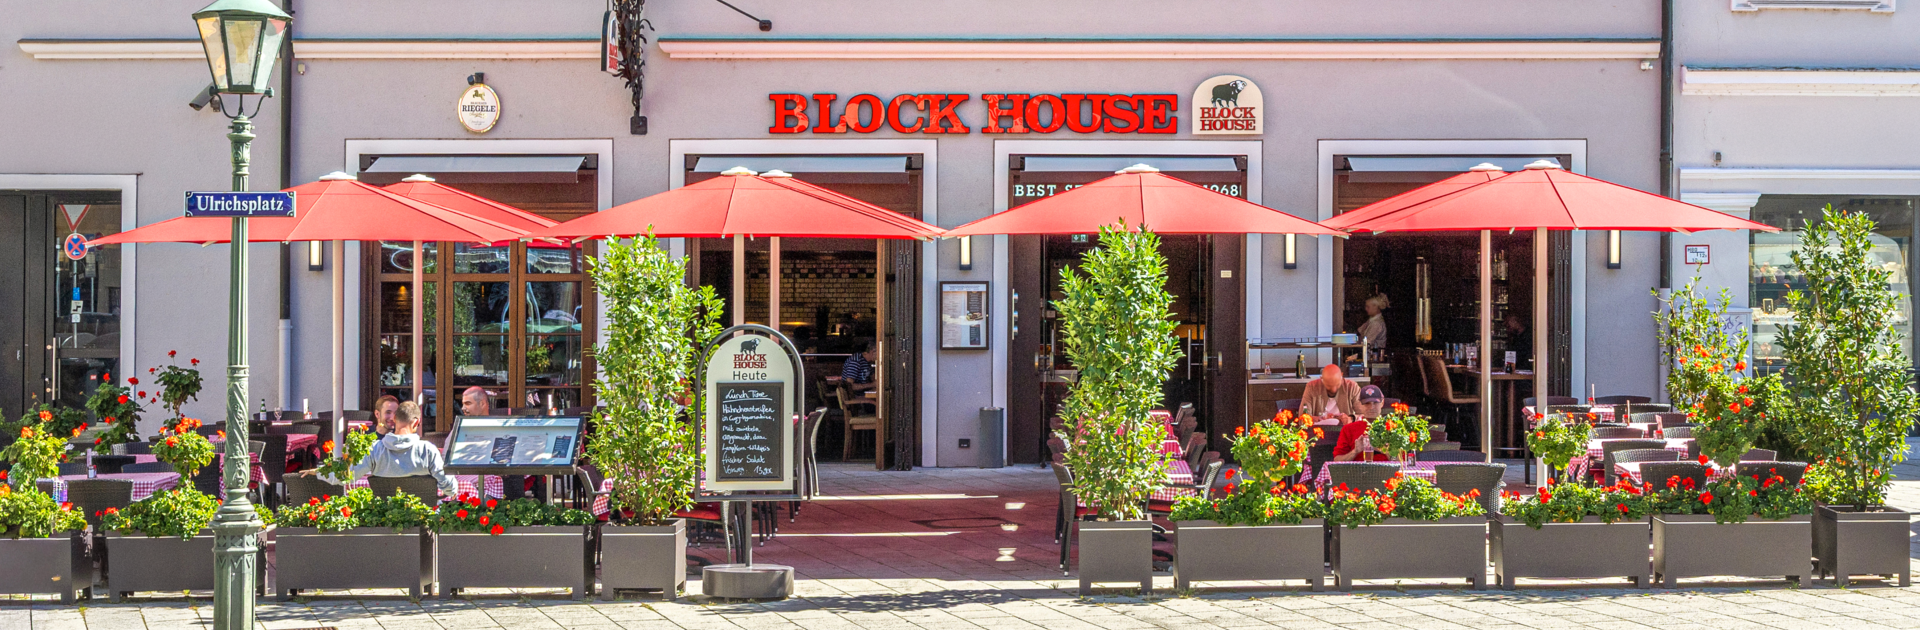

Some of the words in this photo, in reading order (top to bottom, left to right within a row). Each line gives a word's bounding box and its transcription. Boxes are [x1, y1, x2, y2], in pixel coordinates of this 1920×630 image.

[769, 94, 970, 133] BLOCK
[982, 94, 1178, 133] HOUSE
[1200, 107, 1255, 119] BLOCK
[1200, 119, 1256, 131] HOUSE
[1014, 184, 1057, 197] BEST
[1203, 184, 1239, 197] 968
[196, 195, 284, 214] Ulrichsplatz
[733, 353, 767, 362] BLOCK
[733, 361, 767, 369] HOUSE
[733, 370, 767, 380] Heute
[725, 388, 749, 399] Lunch
[748, 389, 768, 398] Time
